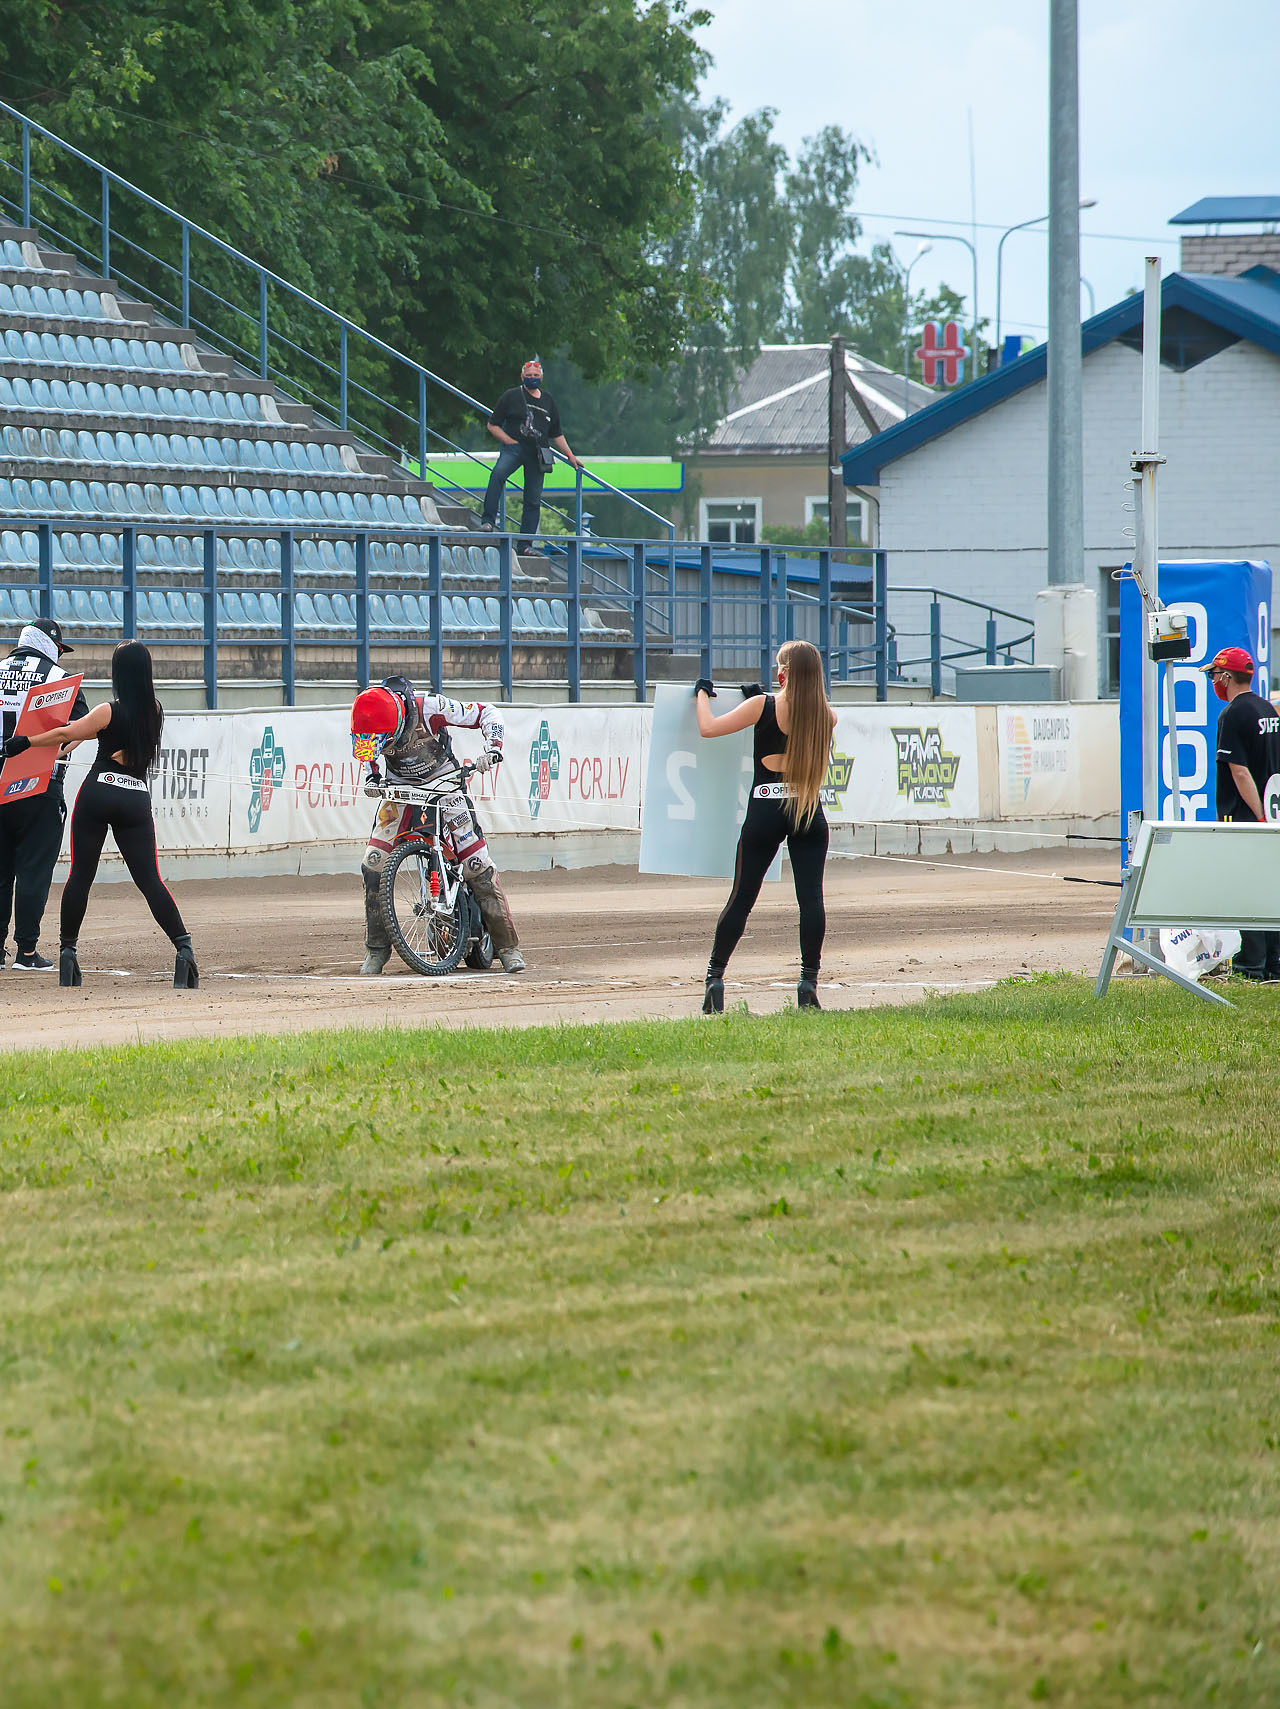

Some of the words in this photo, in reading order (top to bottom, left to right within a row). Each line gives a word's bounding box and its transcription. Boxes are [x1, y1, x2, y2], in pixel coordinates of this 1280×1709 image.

[1033, 718, 1070, 740] DAUGAVPILS
[295, 762, 362, 808] PCR.LV
[569, 756, 629, 800] PCR.LV
